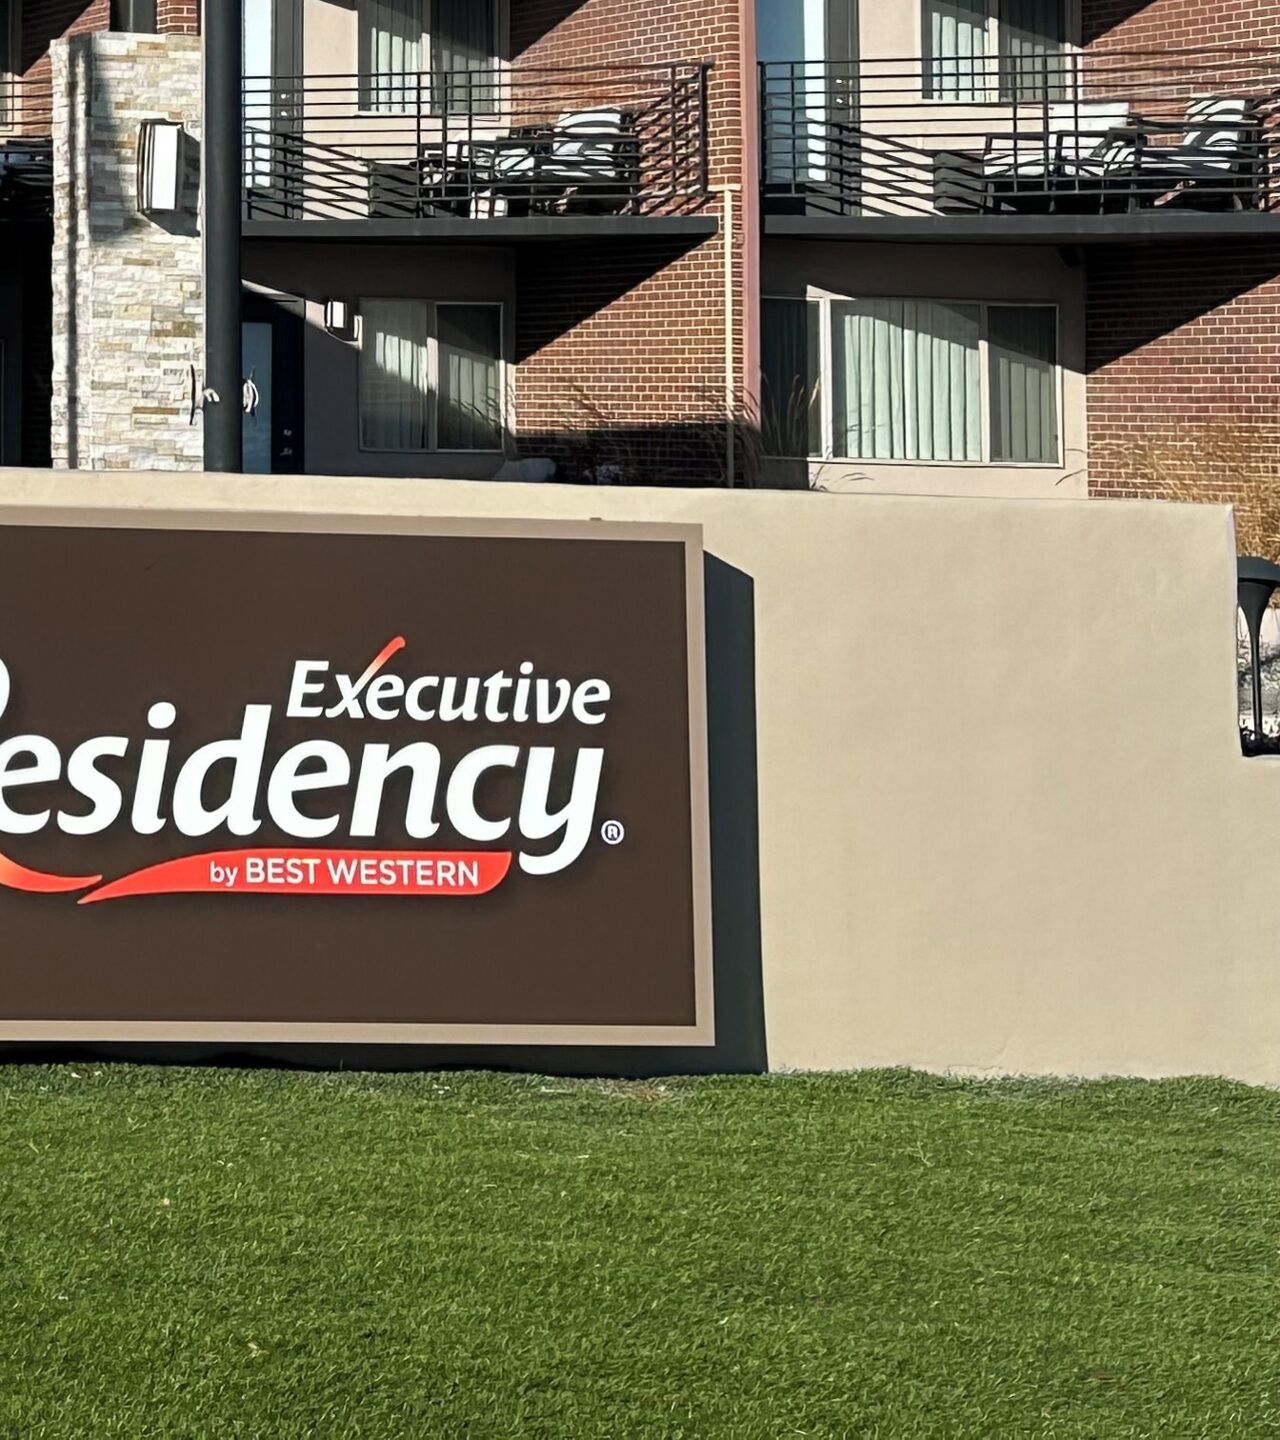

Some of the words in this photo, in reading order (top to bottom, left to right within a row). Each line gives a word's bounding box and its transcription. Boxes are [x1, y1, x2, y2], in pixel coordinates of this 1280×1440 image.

[286, 638, 611, 725] Executive
[209, 861, 238, 887] by
[245, 857, 321, 885] BEST
[326, 858, 479, 887] WESTERN
